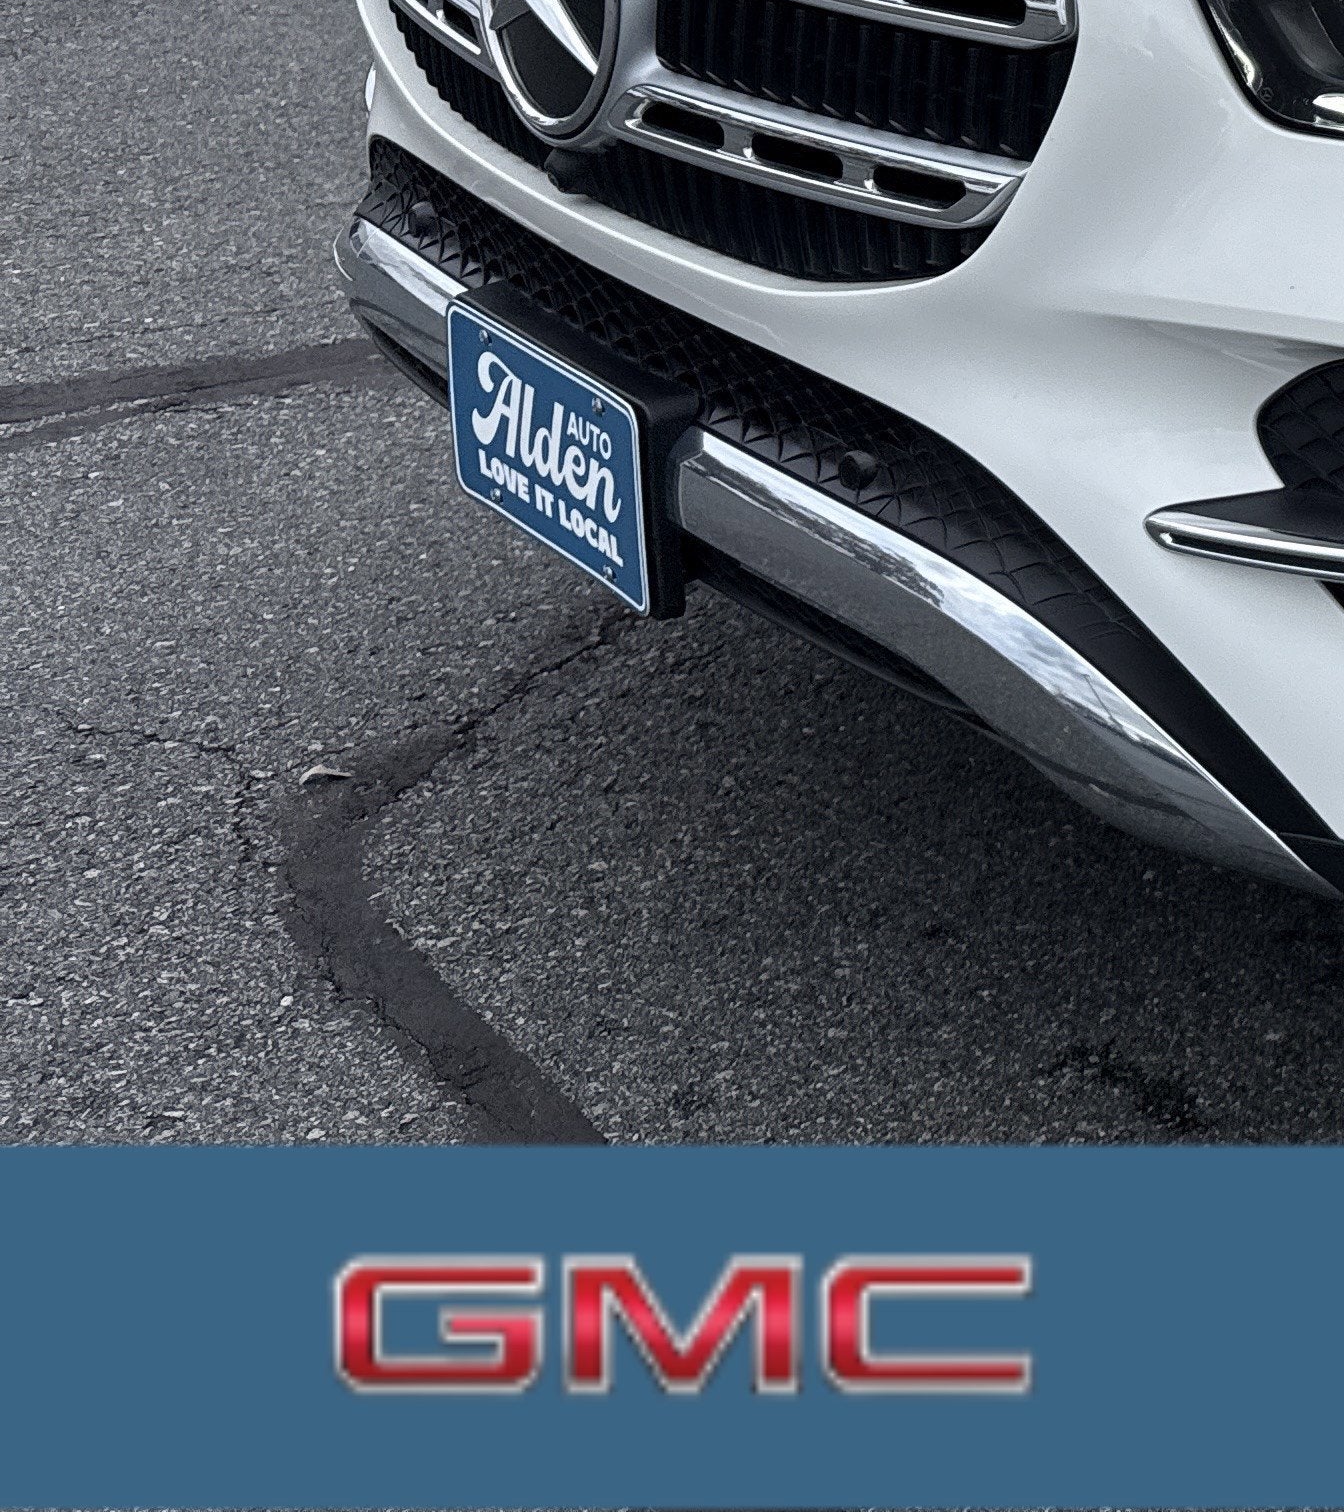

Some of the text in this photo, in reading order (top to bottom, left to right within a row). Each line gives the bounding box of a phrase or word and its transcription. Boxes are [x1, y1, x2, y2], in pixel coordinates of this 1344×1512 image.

[471, 350, 622, 523] Alden
[565, 410, 613, 461] AUTO
[477, 448, 624, 568] LOVE IT LOCAL
